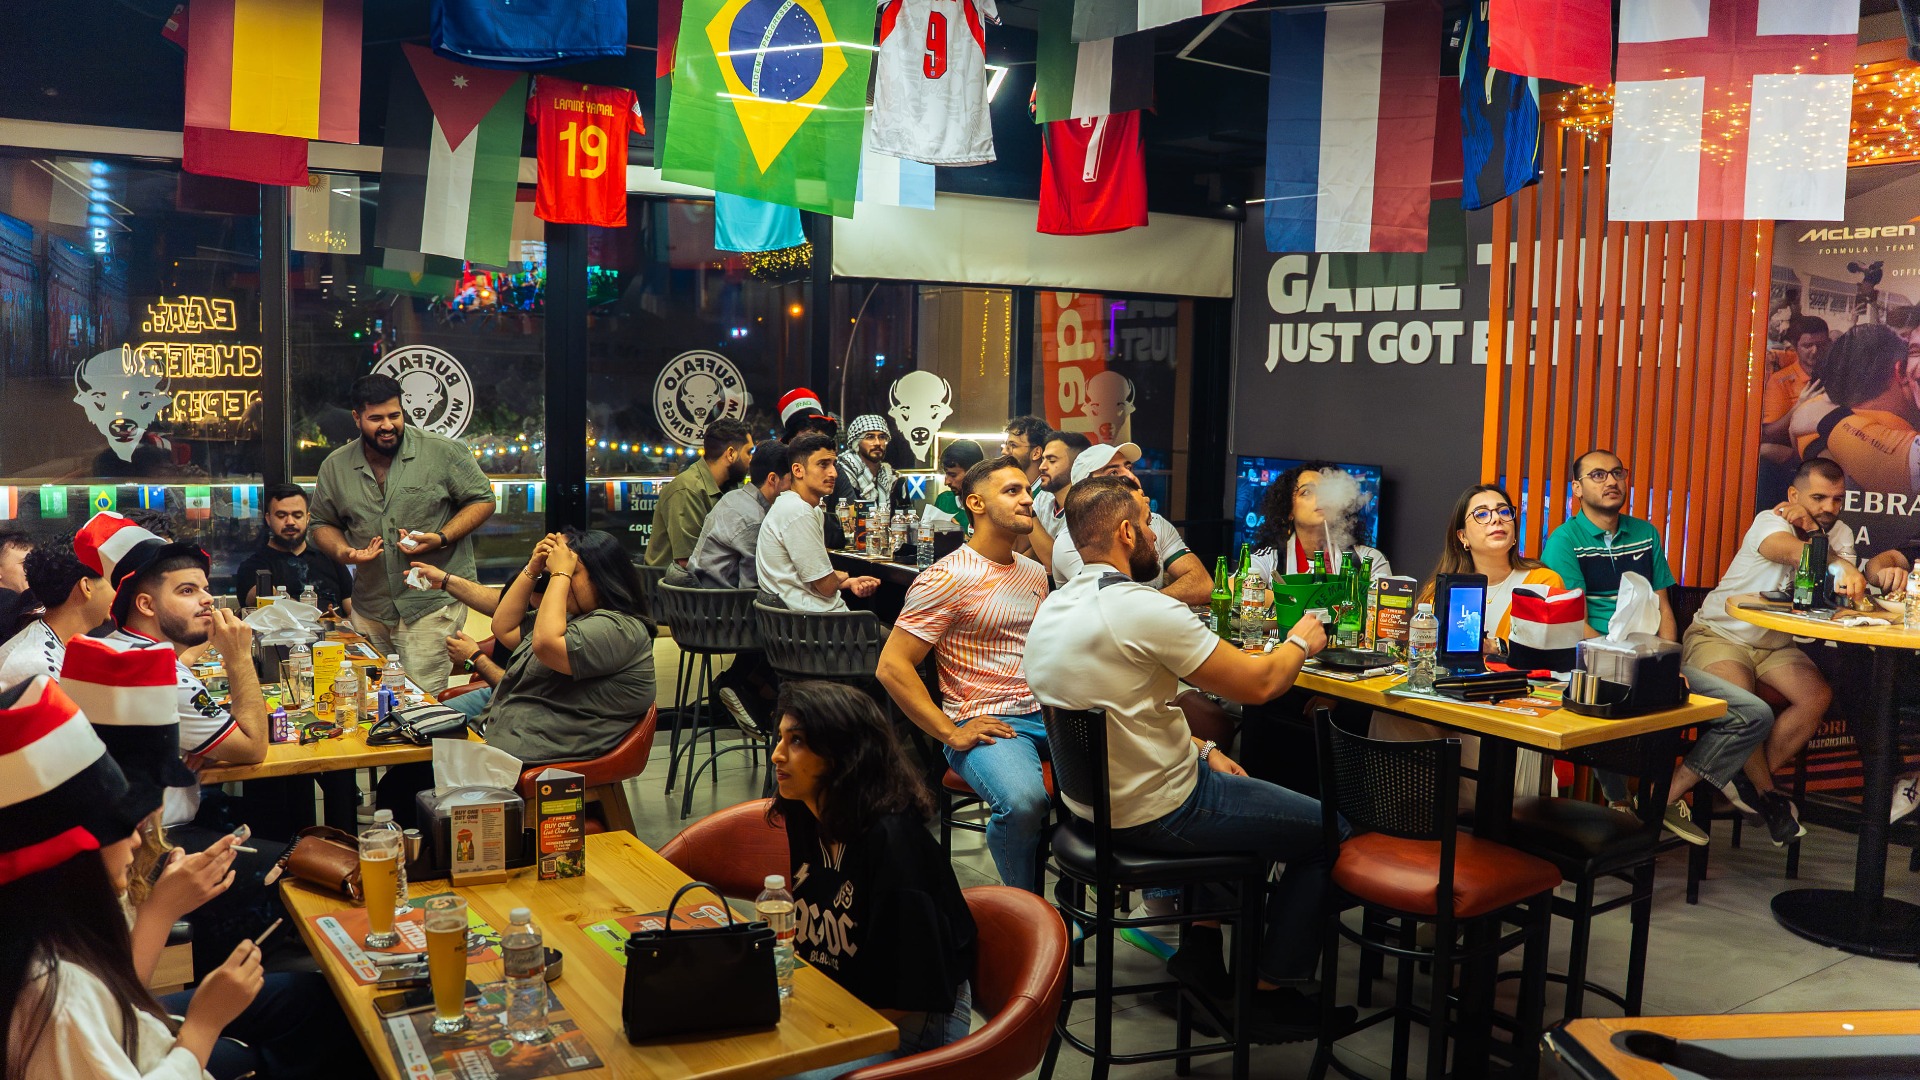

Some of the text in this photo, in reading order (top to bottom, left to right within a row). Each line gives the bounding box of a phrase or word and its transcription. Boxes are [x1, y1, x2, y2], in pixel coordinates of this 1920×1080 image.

[753, 61, 762, 93] ORDEM
[761, 1, 792, 48] PROGRESSO
[923, 10, 948, 80] 9
[554, 98, 615, 117] LAMINE YAMAL
[559, 121, 608, 179] 19
[1798, 224, 1916, 242] McLaren
[1819, 246, 1868, 255] FORMULA
[1885, 243, 1914, 252] TEAM
[1264, 321, 1363, 373] JUST
[1368, 320, 1465, 365] GOT
[1854, 525, 1871, 546] A
